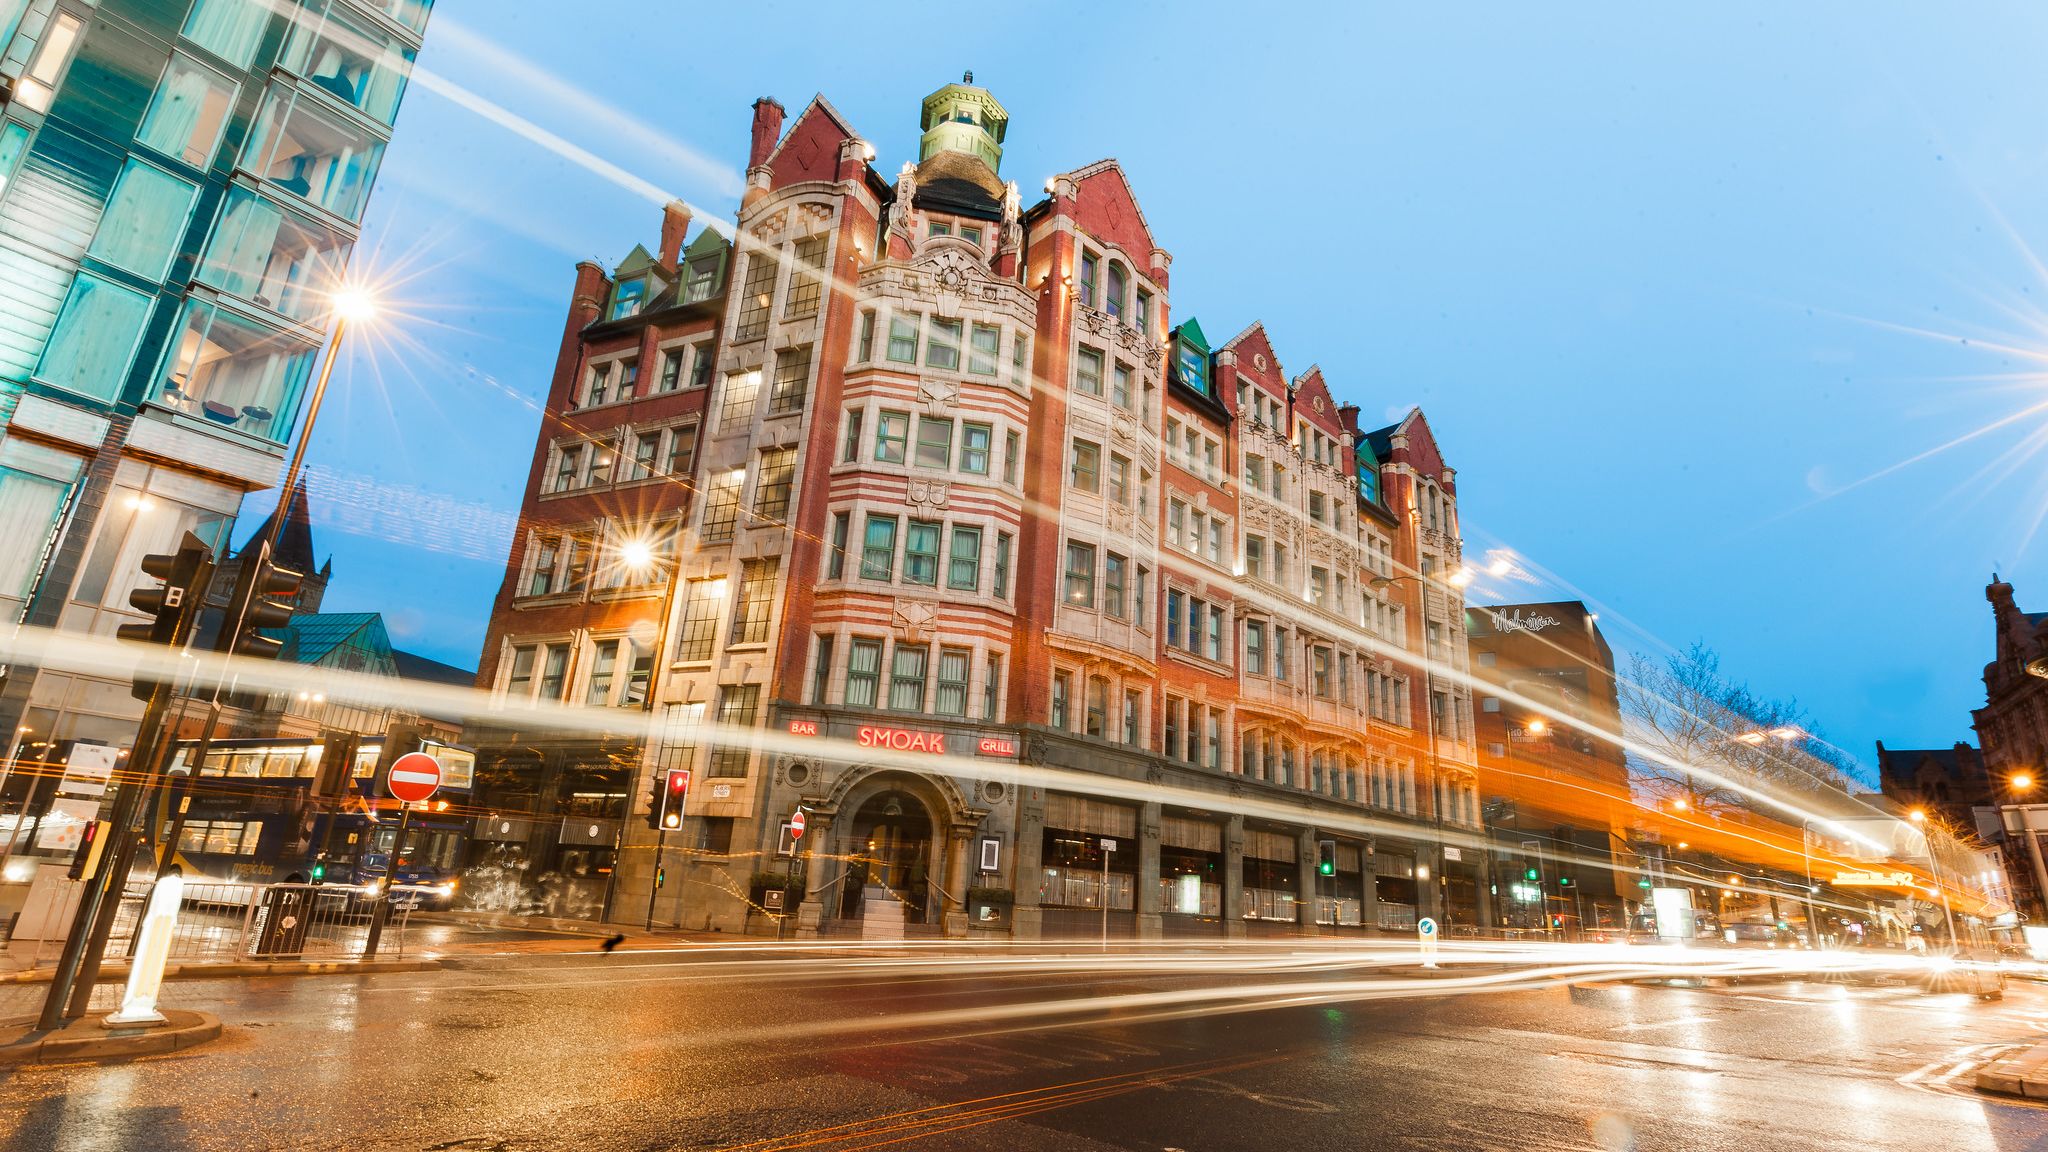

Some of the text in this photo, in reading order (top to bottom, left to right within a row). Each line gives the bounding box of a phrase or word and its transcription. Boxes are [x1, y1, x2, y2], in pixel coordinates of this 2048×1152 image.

[791, 723, 815, 735] BAR
[859, 727, 945, 753] SMOAK
[980, 740, 1013, 753] GRILL
[232, 860, 273, 877] magic bus
